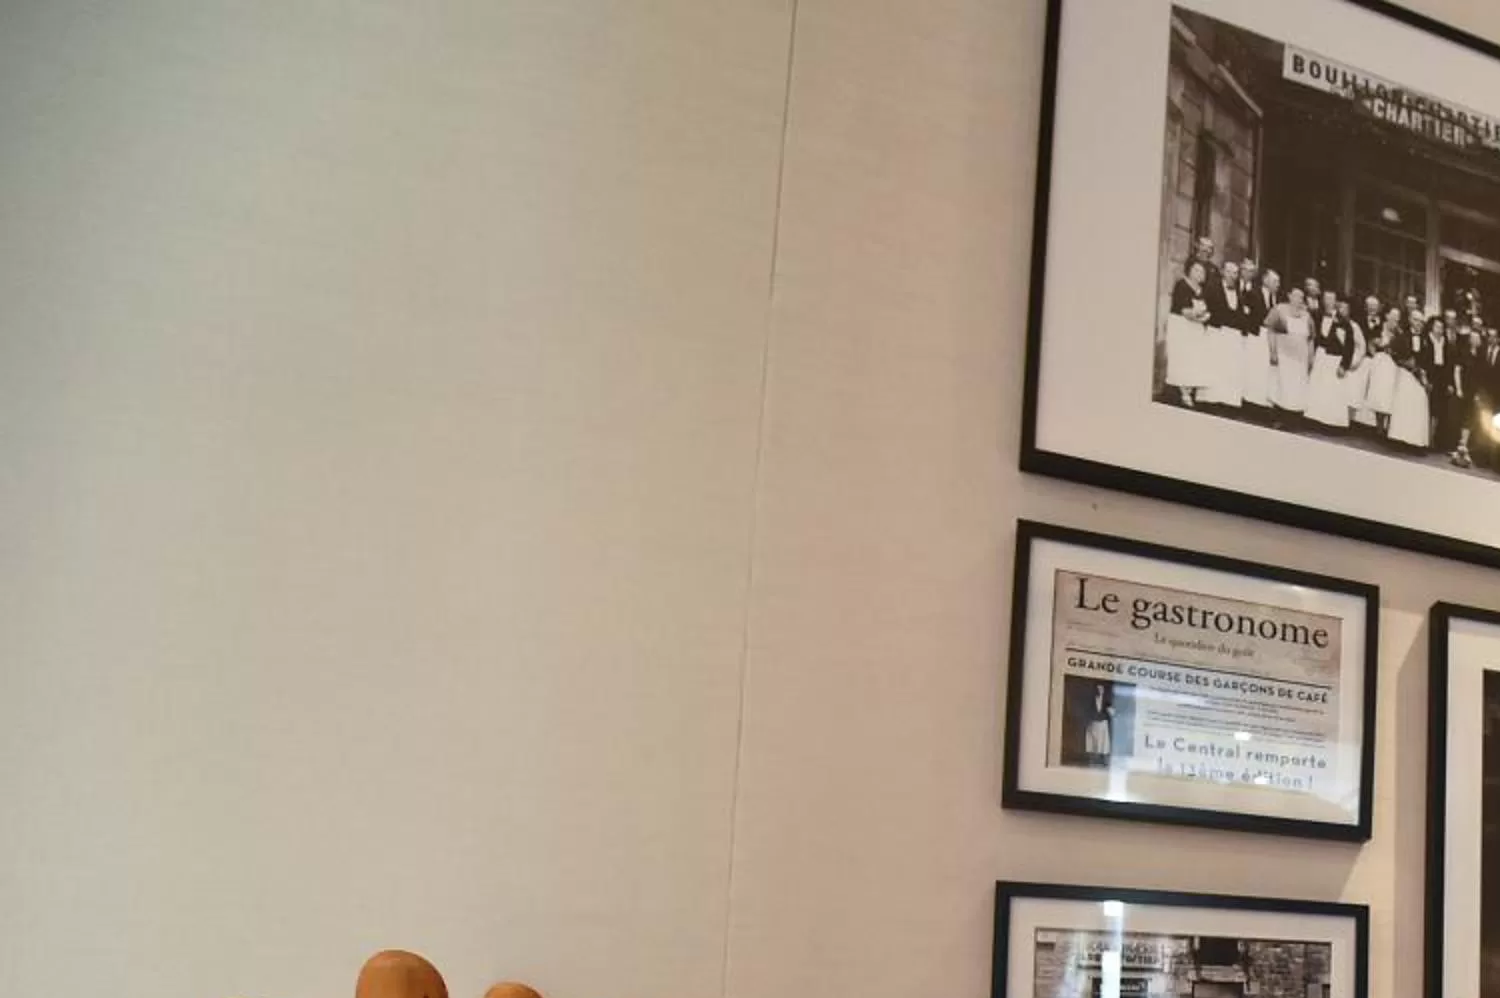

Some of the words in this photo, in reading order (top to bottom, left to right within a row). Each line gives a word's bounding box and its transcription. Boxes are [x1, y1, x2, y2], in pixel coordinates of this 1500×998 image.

[1074, 577, 1120, 613] Le
[1131, 598, 1330, 649] gastronome
[1067, 657, 1124, 675] GRANDE
[1127, 665, 1180, 682] COURSE
[1185, 674, 1209, 687] DES
[1213, 678, 1275, 694] GARÇONS
[1278, 689, 1293, 699] DE
[1297, 691, 1328, 703] CAFÉ
[1144, 734, 1166, 749] Le
[1173, 736, 1240, 759] Central
[1246, 750, 1327, 769] remporte
